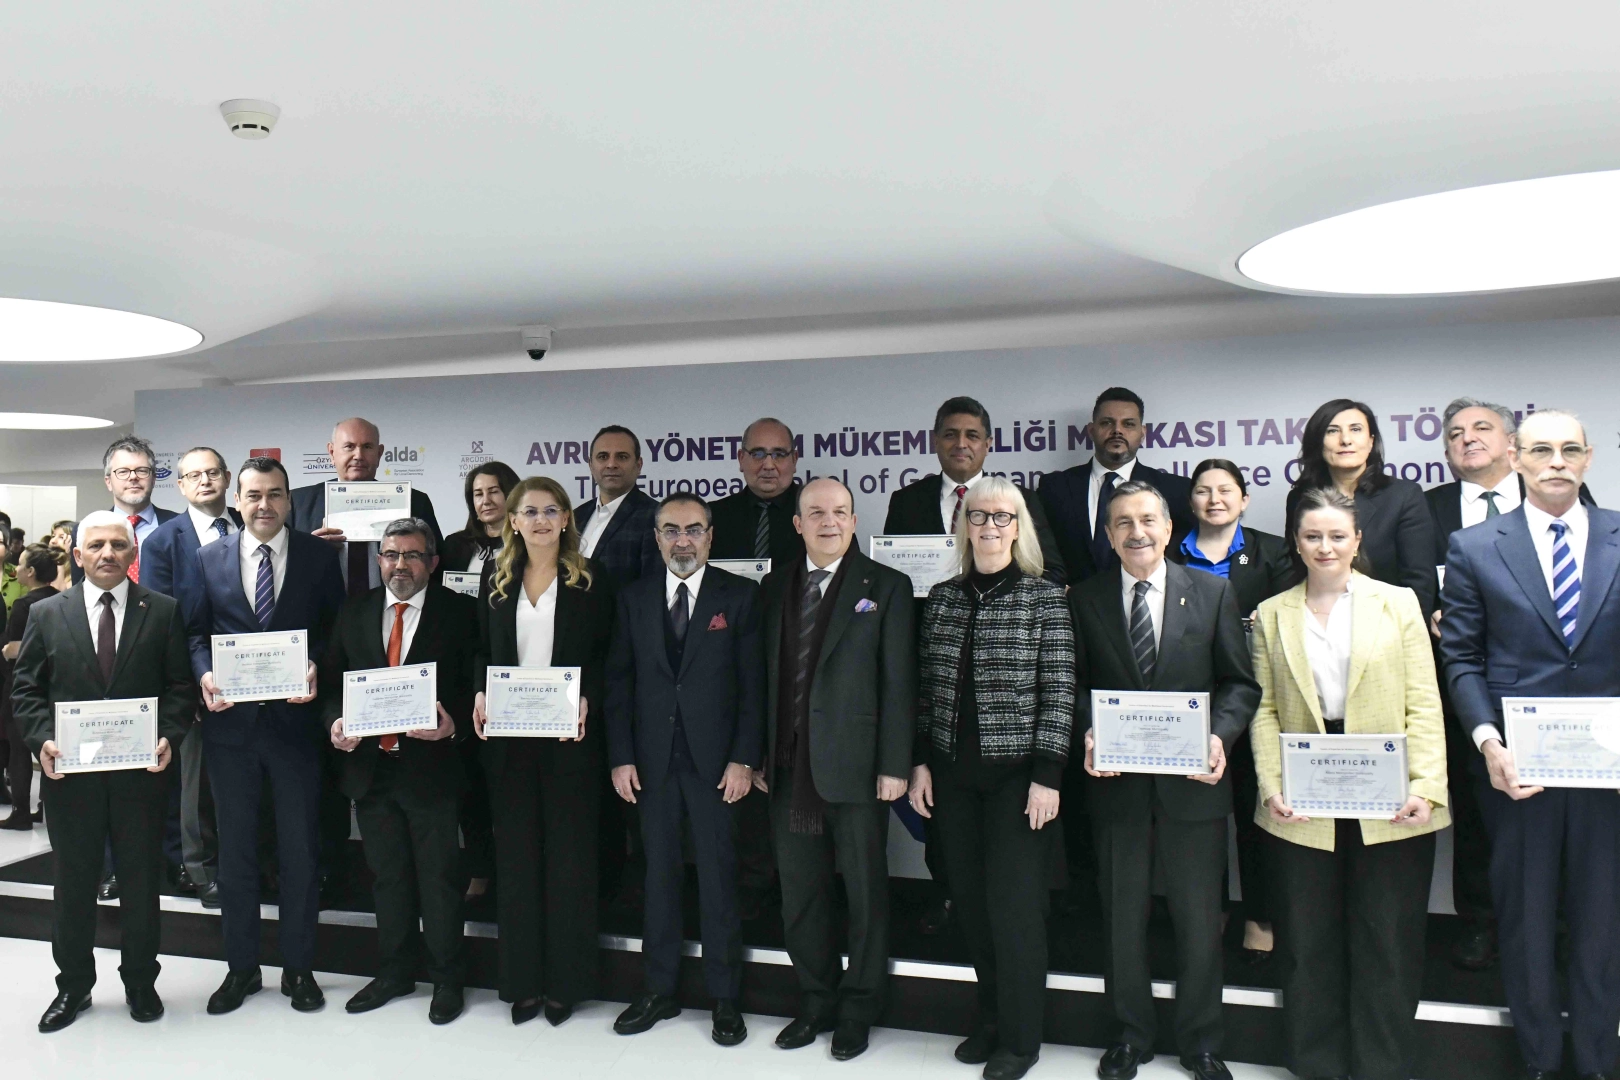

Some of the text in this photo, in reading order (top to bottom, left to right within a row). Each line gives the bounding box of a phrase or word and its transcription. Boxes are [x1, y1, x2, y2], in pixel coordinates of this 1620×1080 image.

[526, 441, 590, 465] AVR
[645, 433, 803, 462] YÖNET
[814, 420, 1056, 457] MÜKEMLİĞİ
[1068, 420, 1226, 450] MKASI
[385, 446, 418, 462] alda
[461, 455, 494, 463] ARGÜDEN
[637, 474, 744, 501] uropea
[860, 467, 889, 494] of
[235, 651, 286, 659] CERTIFICATE
[366, 684, 415, 694] CERTIFICATE
[80, 719, 134, 727] CERTIFICATE
